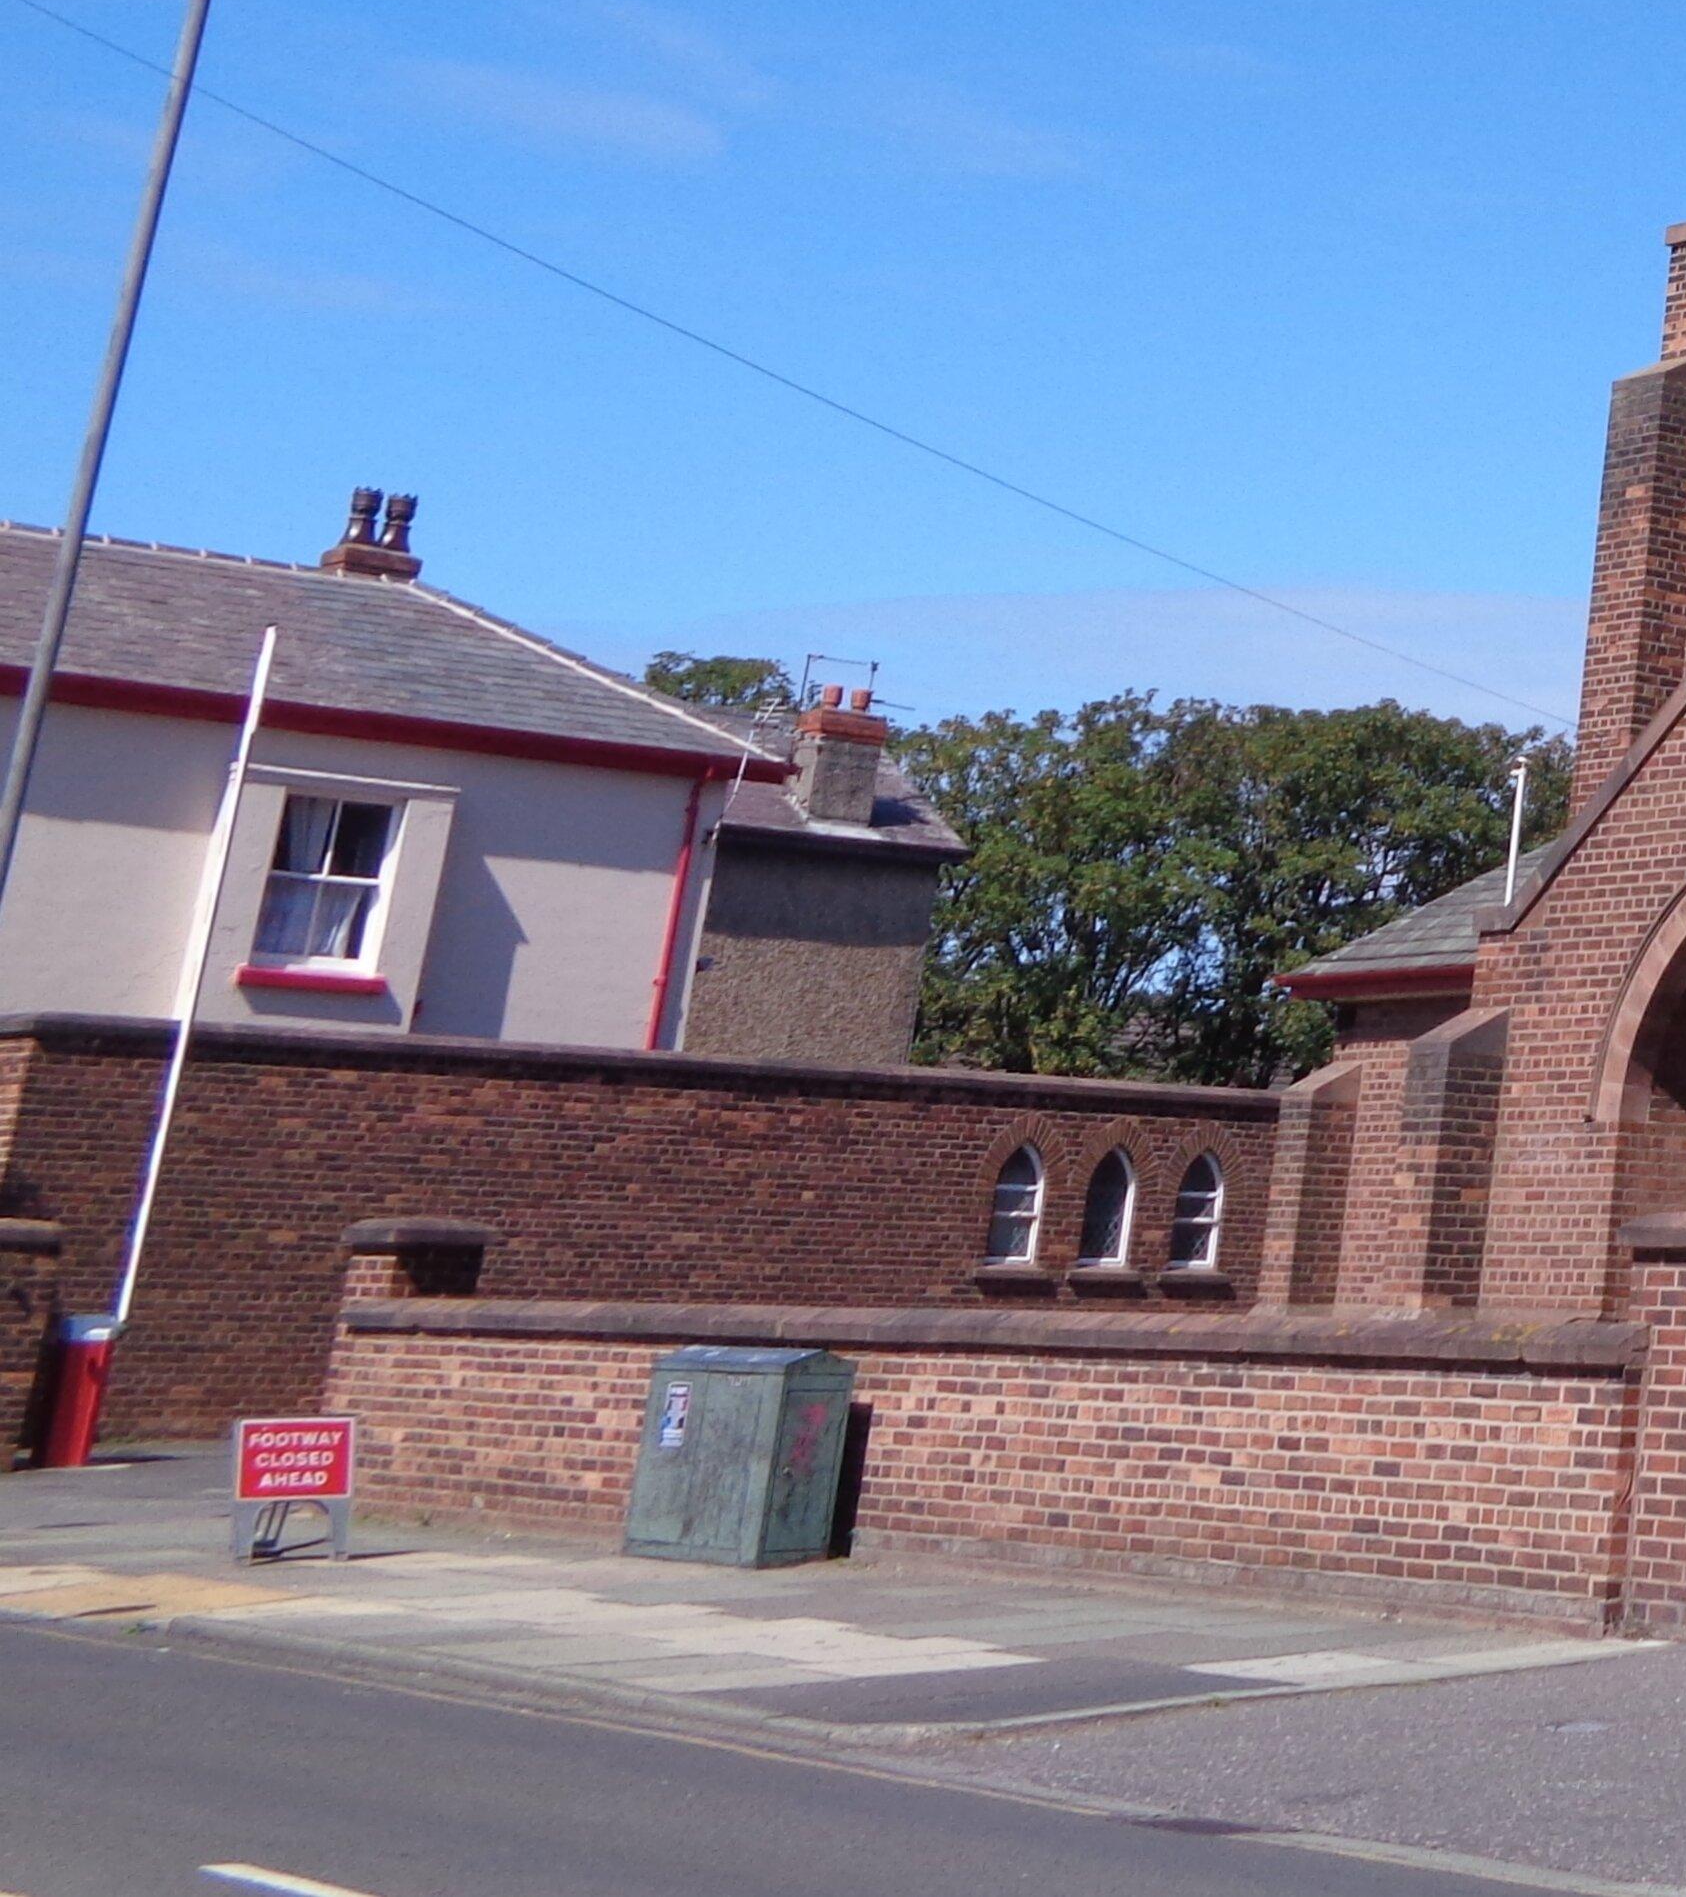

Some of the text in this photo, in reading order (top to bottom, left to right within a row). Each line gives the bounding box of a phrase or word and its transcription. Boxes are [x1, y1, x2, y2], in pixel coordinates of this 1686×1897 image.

[250, 1431, 343, 1447] FOOTWAY
[255, 1451, 334, 1467] CLOSED
[259, 1471, 328, 1488] AHEAD
